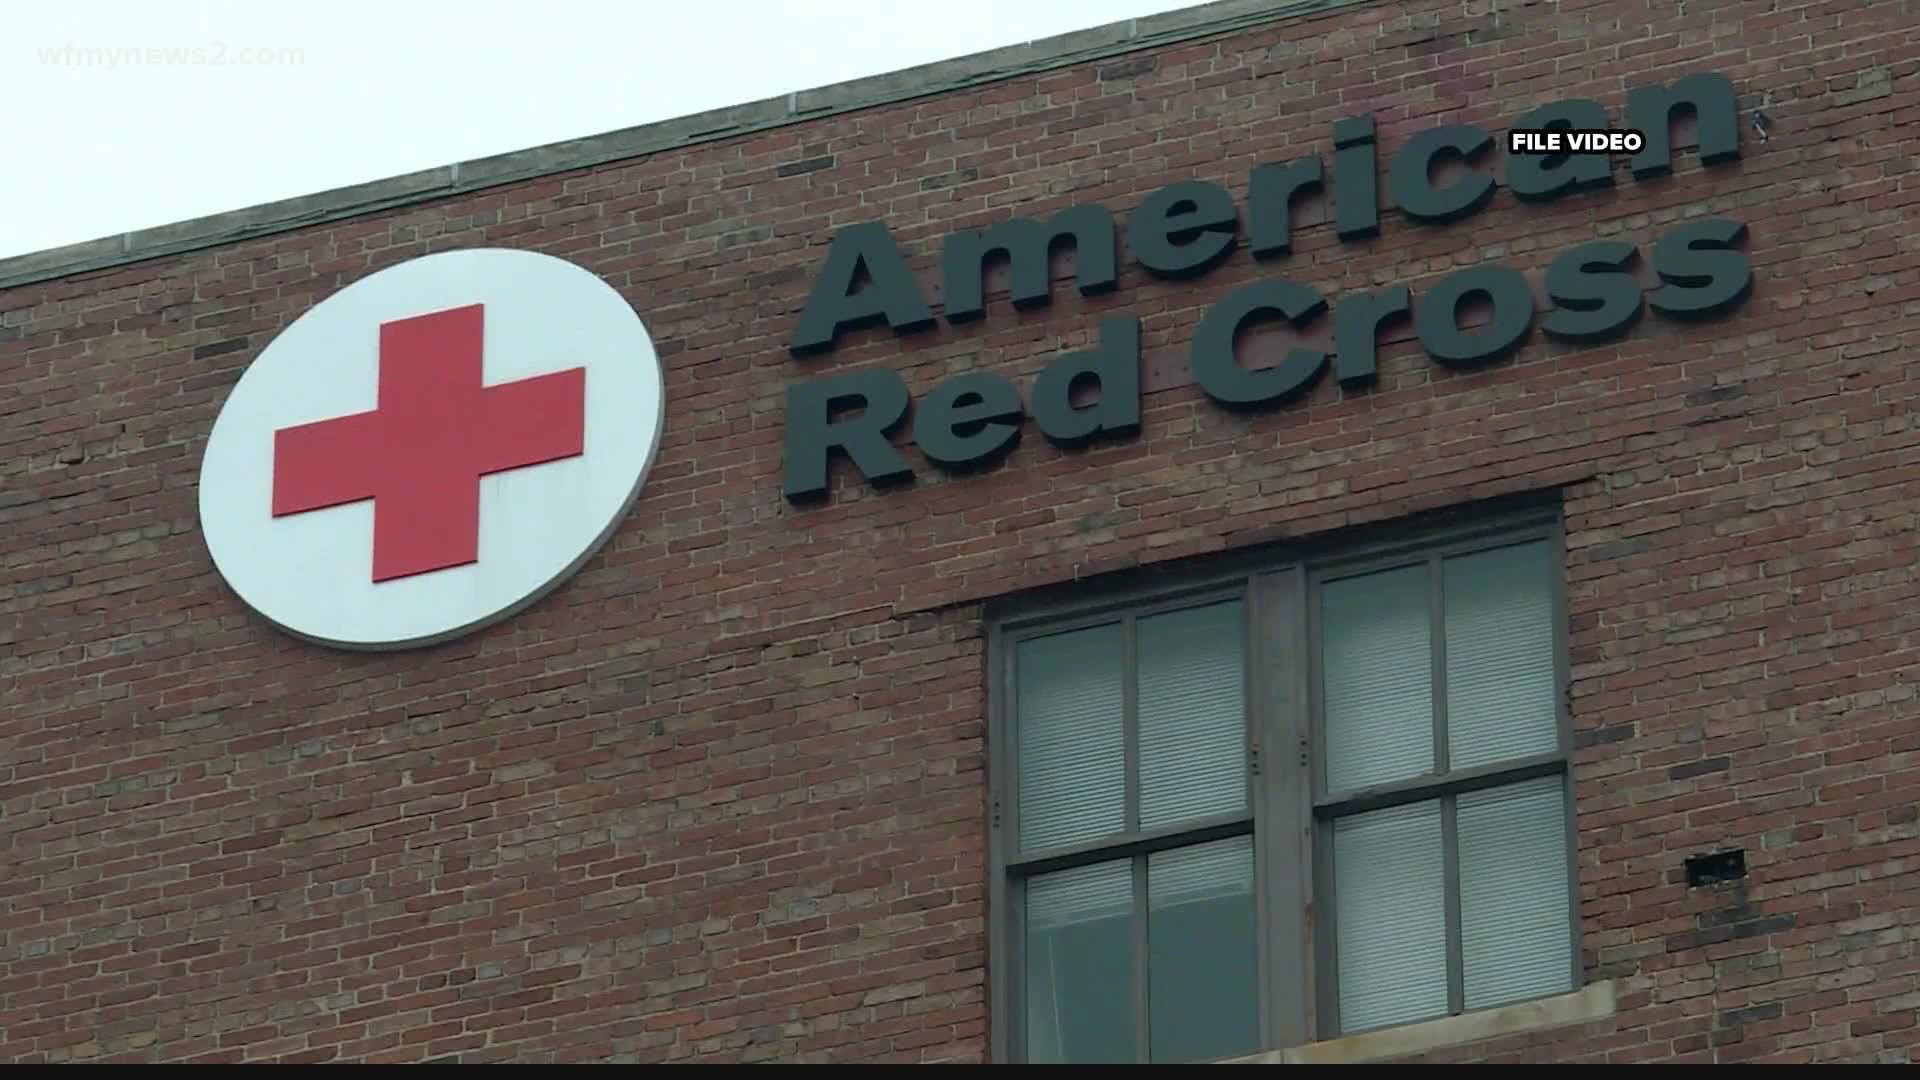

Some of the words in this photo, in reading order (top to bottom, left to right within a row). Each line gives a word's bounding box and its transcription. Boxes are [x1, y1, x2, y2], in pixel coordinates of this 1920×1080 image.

[789, 72, 1741, 357] American
[783, 313, 1142, 503] Red
[1190, 218, 1754, 410] Cross
